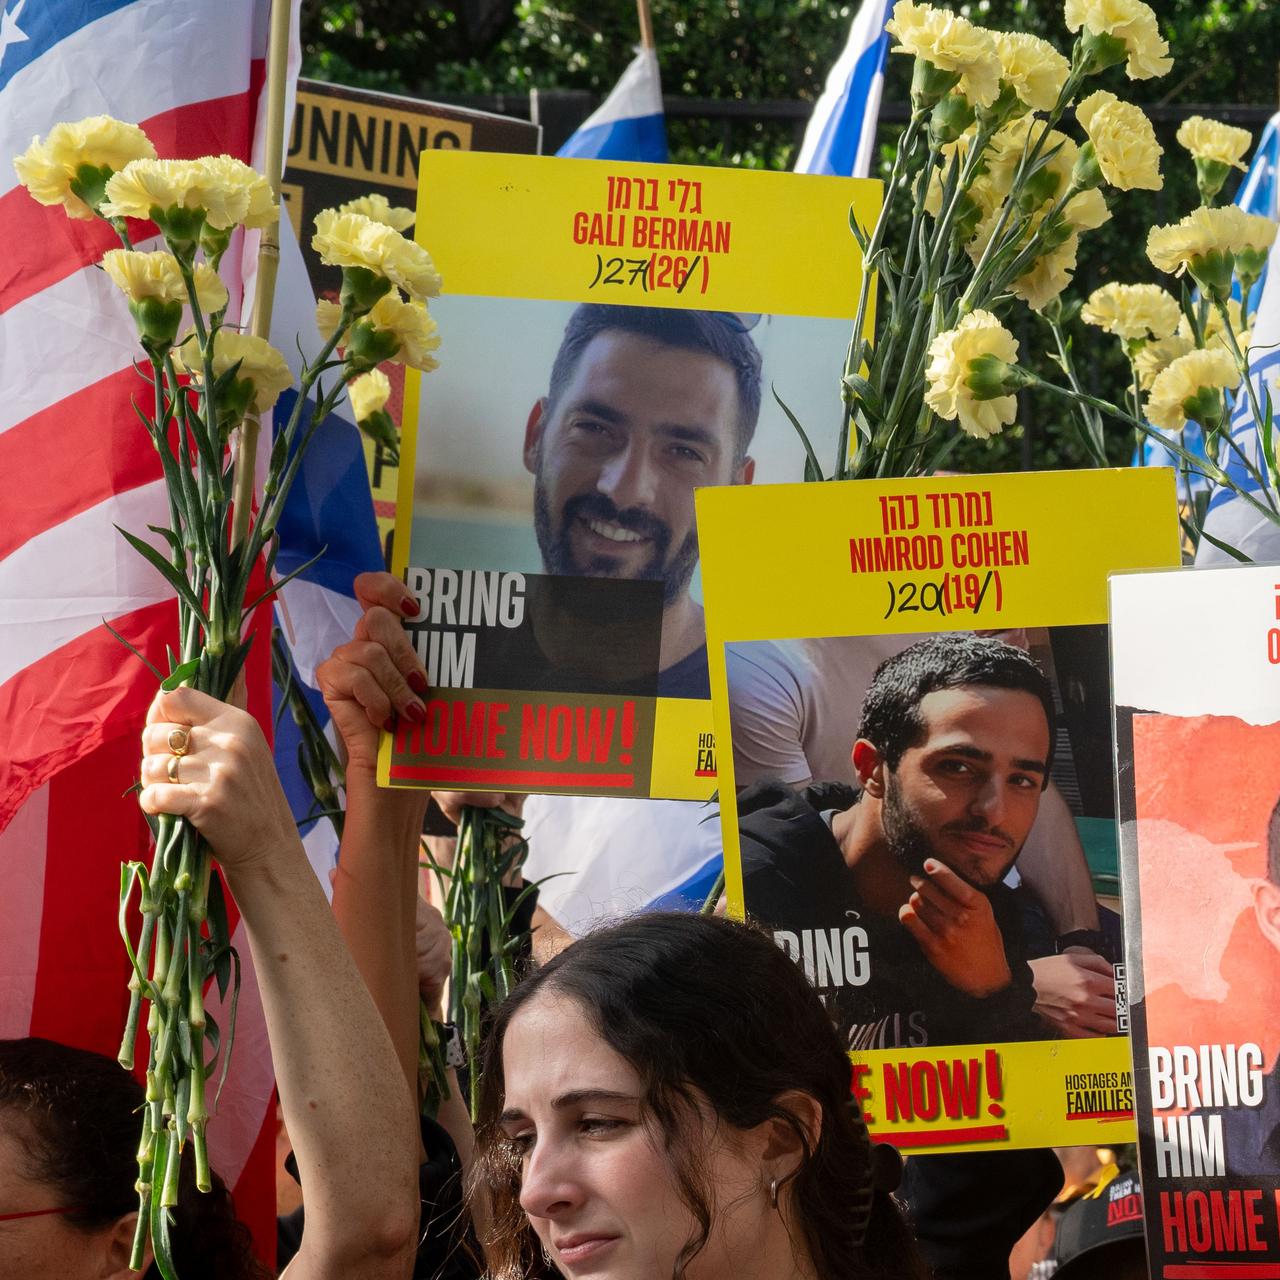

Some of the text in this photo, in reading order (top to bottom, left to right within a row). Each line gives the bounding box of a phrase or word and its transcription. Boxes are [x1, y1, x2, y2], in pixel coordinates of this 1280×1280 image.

[607, 175, 703, 214] גלי ברמן
[573, 211, 731, 254] GALI BERMAN
[878, 490, 994, 535] נמרוד כהן
[848, 530, 1030, 574] NIMROD COHEN
[405, 566, 528, 629] BRING
[394, 699, 510, 760] HOME
[519, 700, 638, 766] NOW!
[882, 1048, 1006, 1122] NOW!
[1064, 1071, 1119, 1091] HOSTAGES
[1066, 1088, 1134, 1115] FAMILIES
[1148, 1042, 1264, 1109] BRING
[1152, 1114, 1226, 1178] HIM
[1159, 1189, 1268, 1253] HOME
